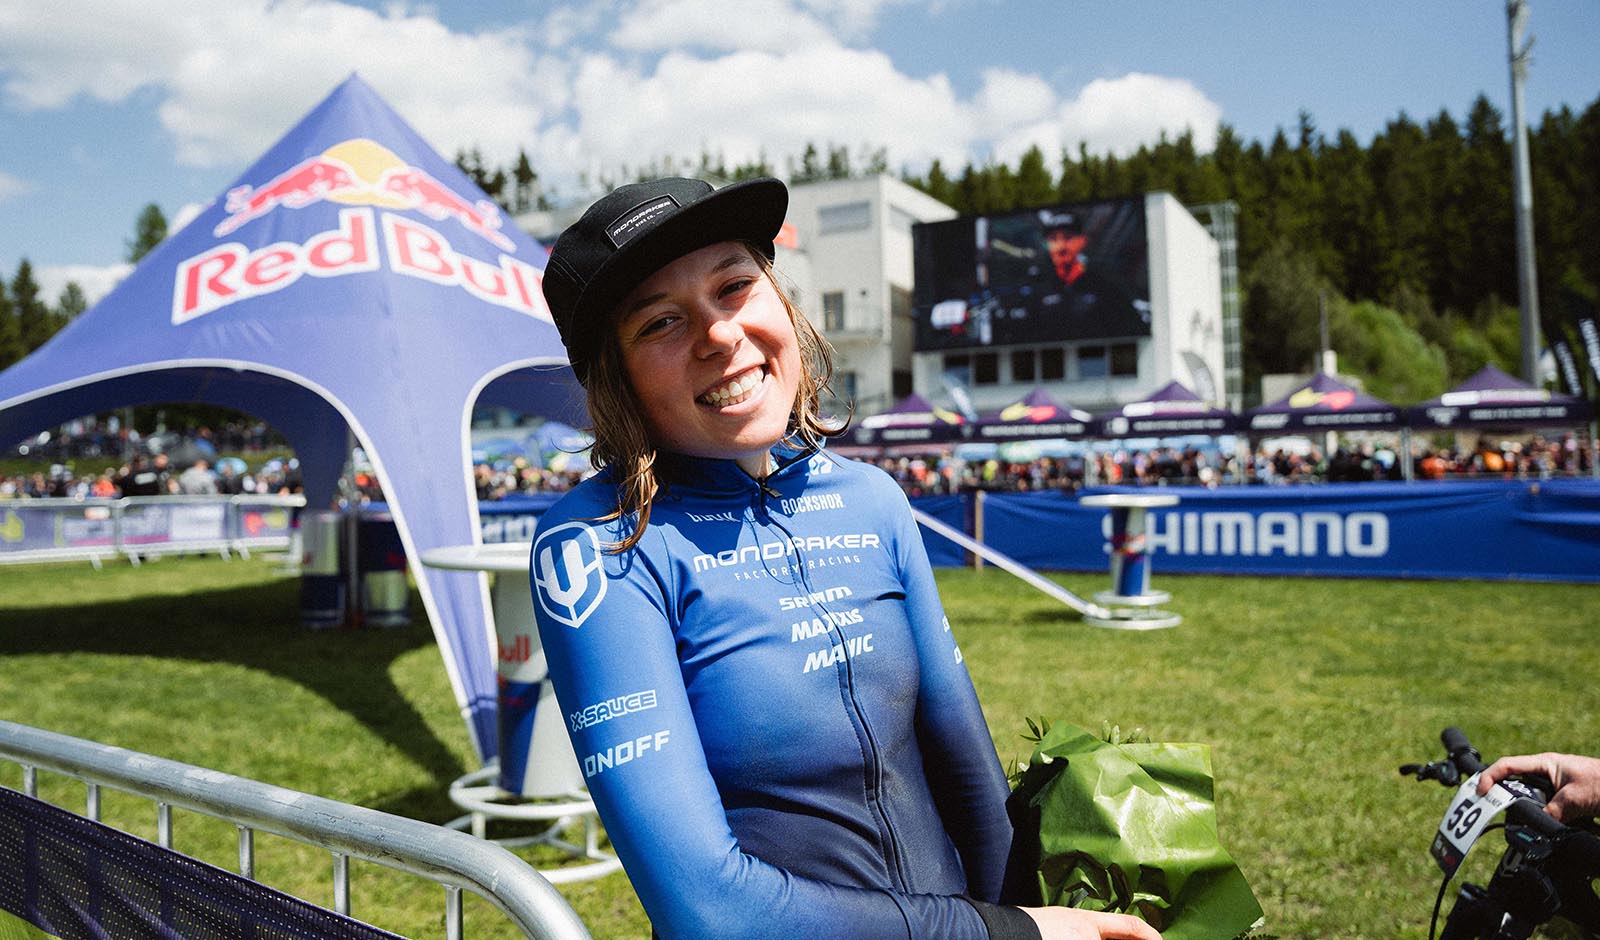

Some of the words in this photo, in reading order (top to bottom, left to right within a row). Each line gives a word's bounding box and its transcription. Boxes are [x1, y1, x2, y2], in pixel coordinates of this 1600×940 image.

[613, 201, 671, 236] MONDRAKER
[178, 211, 374, 320] Red
[781, 493, 844, 515] ROCKSHOX
[693, 533, 880, 573] MONDRAKER
[1102, 511, 1389, 557] HIMANO
[734, 563, 802, 581] FACTORY
[808, 555, 861, 571] RACING
[779, 586, 853, 611] SRAM
[791, 608, 864, 643] MAXXIS
[803, 633, 873, 674] MAVIC
[584, 730, 670, 778] ONOFF
[1447, 798, 1482, 840] 59
